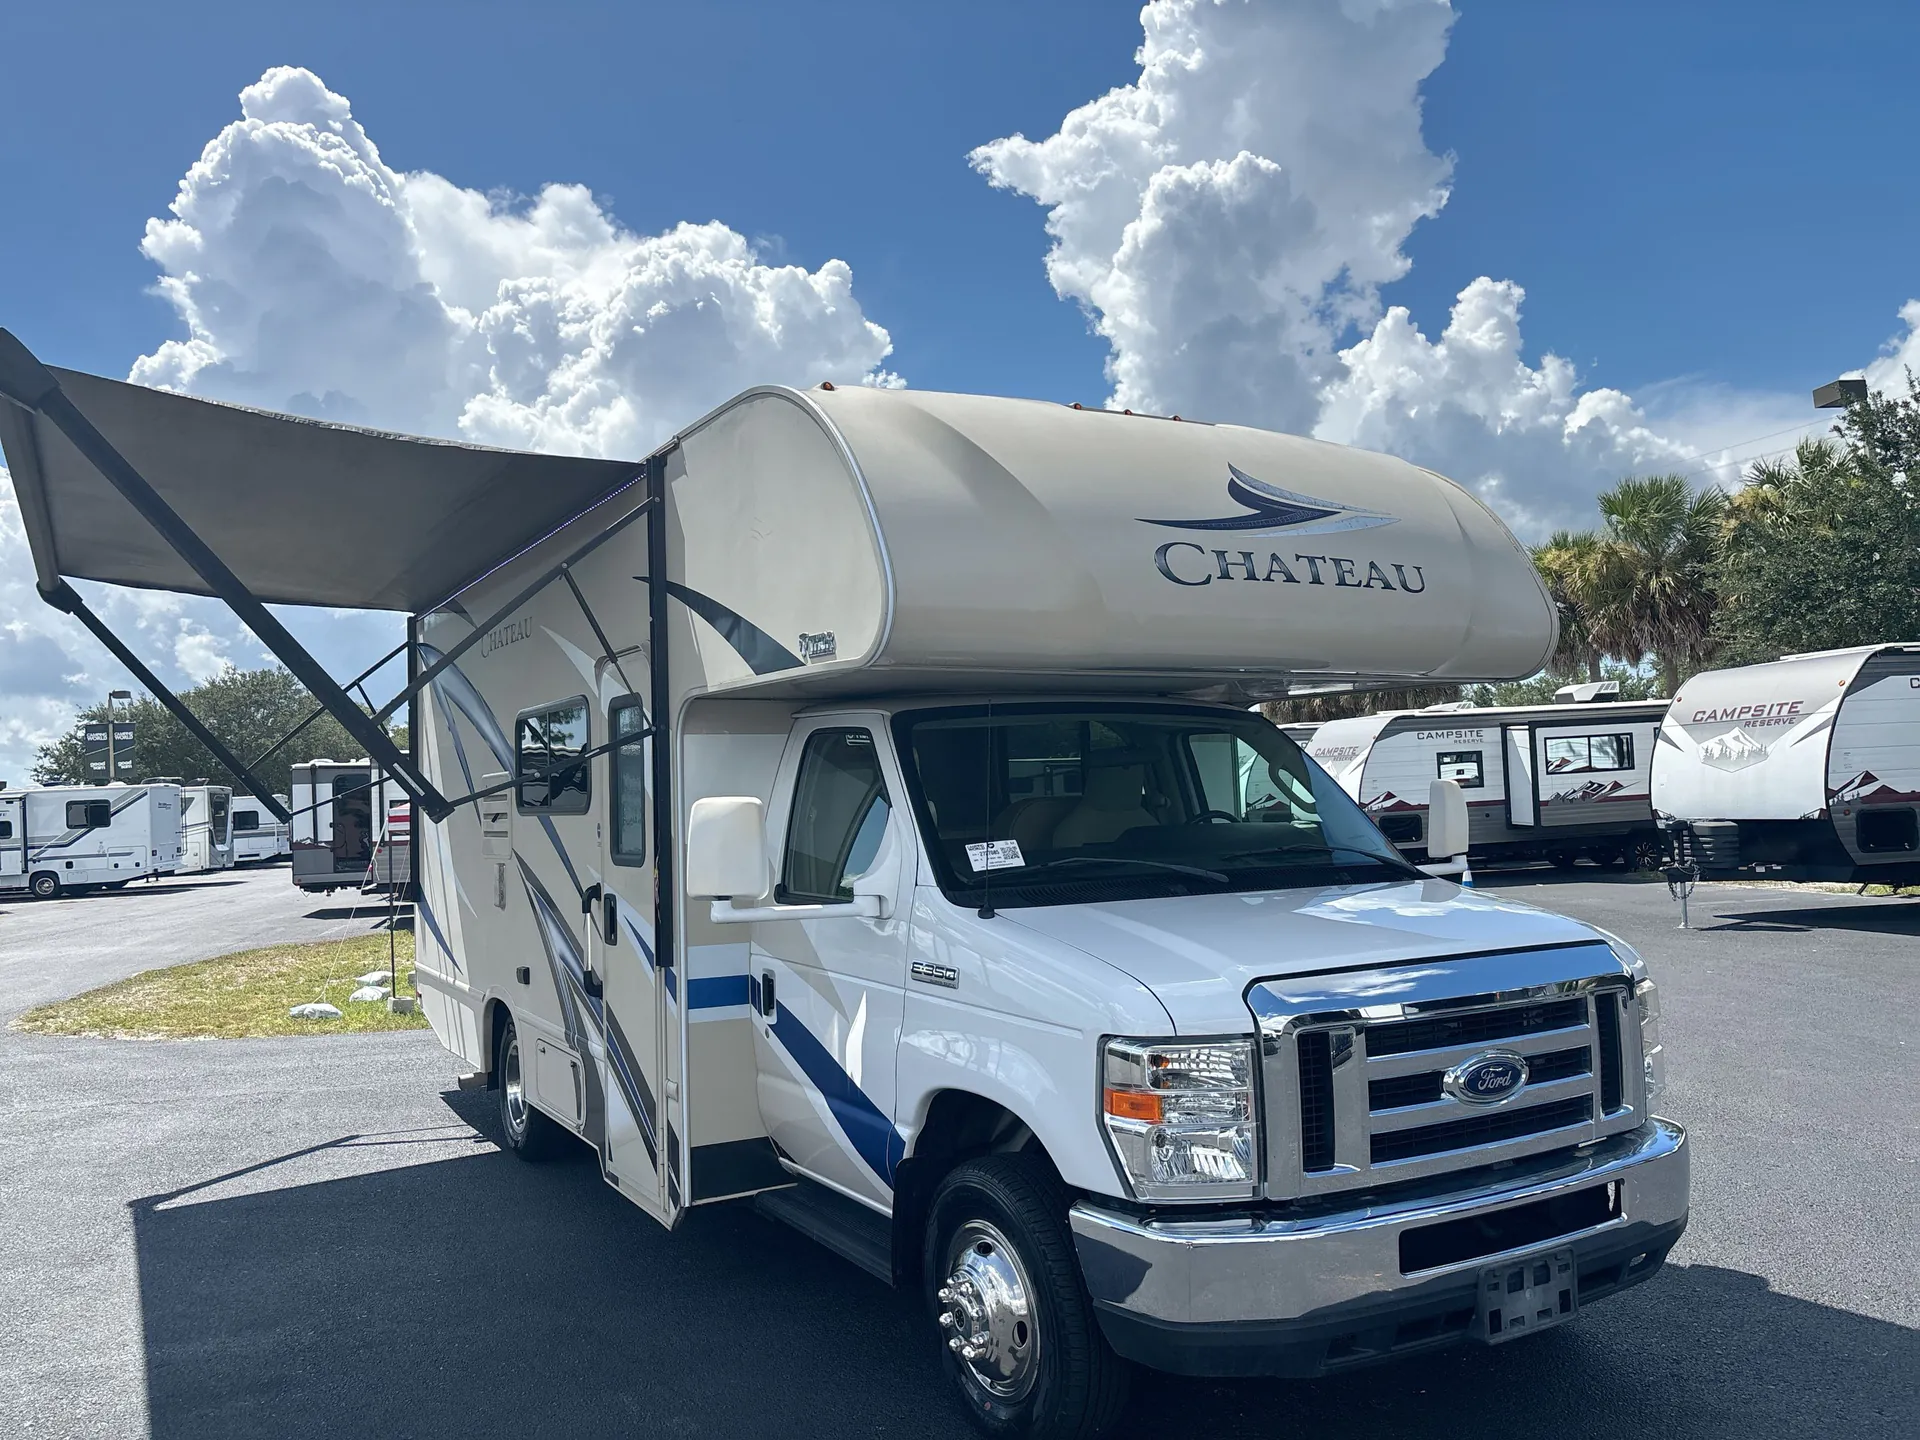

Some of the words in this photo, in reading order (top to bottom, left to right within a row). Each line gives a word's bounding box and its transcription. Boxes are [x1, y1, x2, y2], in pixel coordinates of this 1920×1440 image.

[1154, 541, 1427, 594] CHATEAU
[1692, 700, 1804, 723] CAMPSITE
[1743, 717, 1796, 728] RESERVE
[1416, 730, 1483, 740] CAMPSITE
[1314, 746, 1359, 756] CAMPSITE
[1477, 1066, 1513, 1090] Ford
